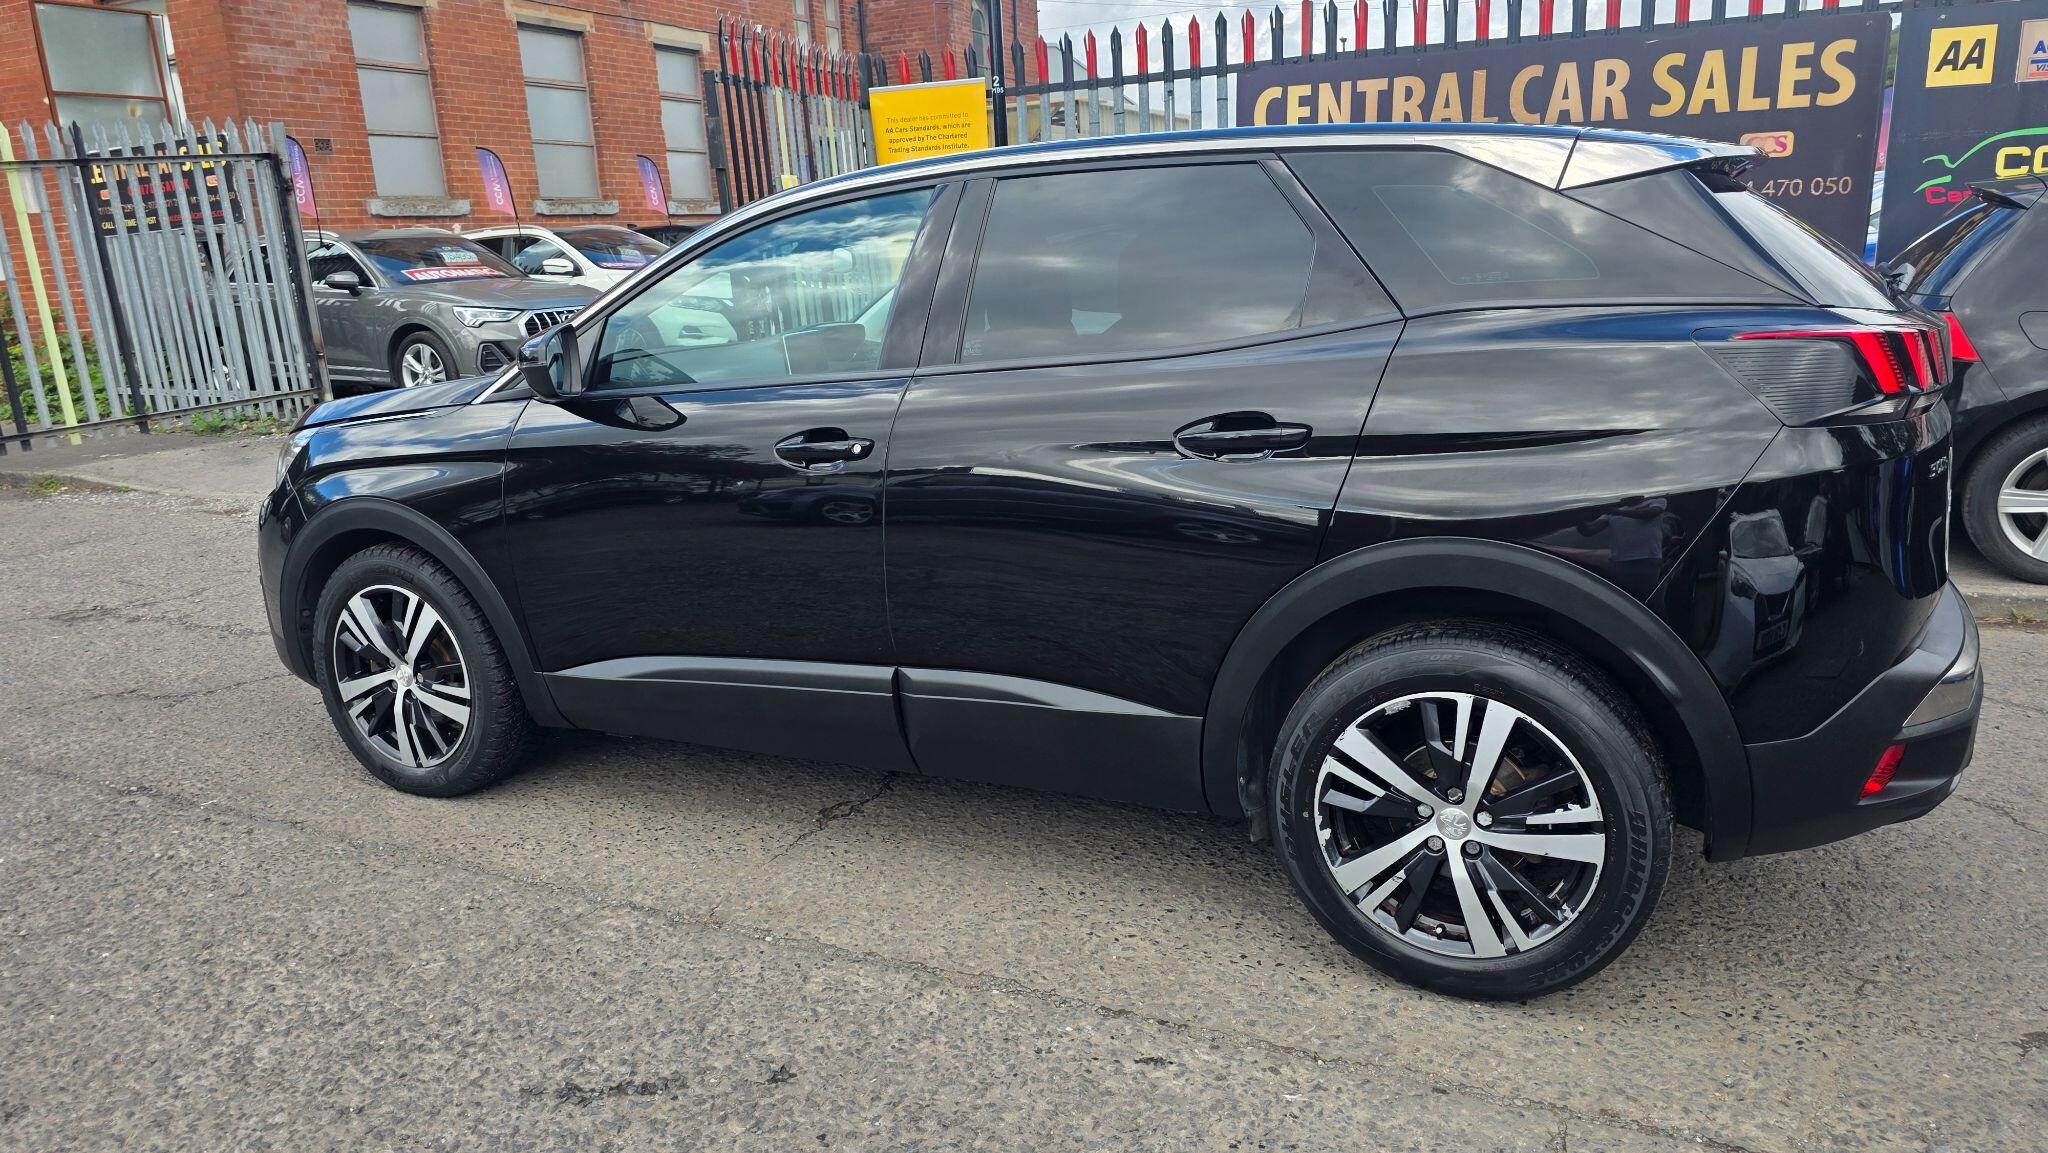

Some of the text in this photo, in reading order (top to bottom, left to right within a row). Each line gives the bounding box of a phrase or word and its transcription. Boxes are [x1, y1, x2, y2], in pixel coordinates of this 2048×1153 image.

[1934, 38, 1986, 73] AA
[992, 75, 1000, 86] 2
[1253, 39, 1857, 127] CENTRAL CAR SALES
[900, 114, 918, 123] dealer
[930, 112, 962, 121] committed
[895, 126, 909, 134] Cars
[909, 124, 942, 133] Standards,
[942, 122, 961, 130] which
[888, 132, 968, 144] approved by The Chartered
[888, 142, 970, 155] Trading Standards Institute.
[1761, 178, 1803, 197] 470
[1811, 176, 1853, 196] 050
